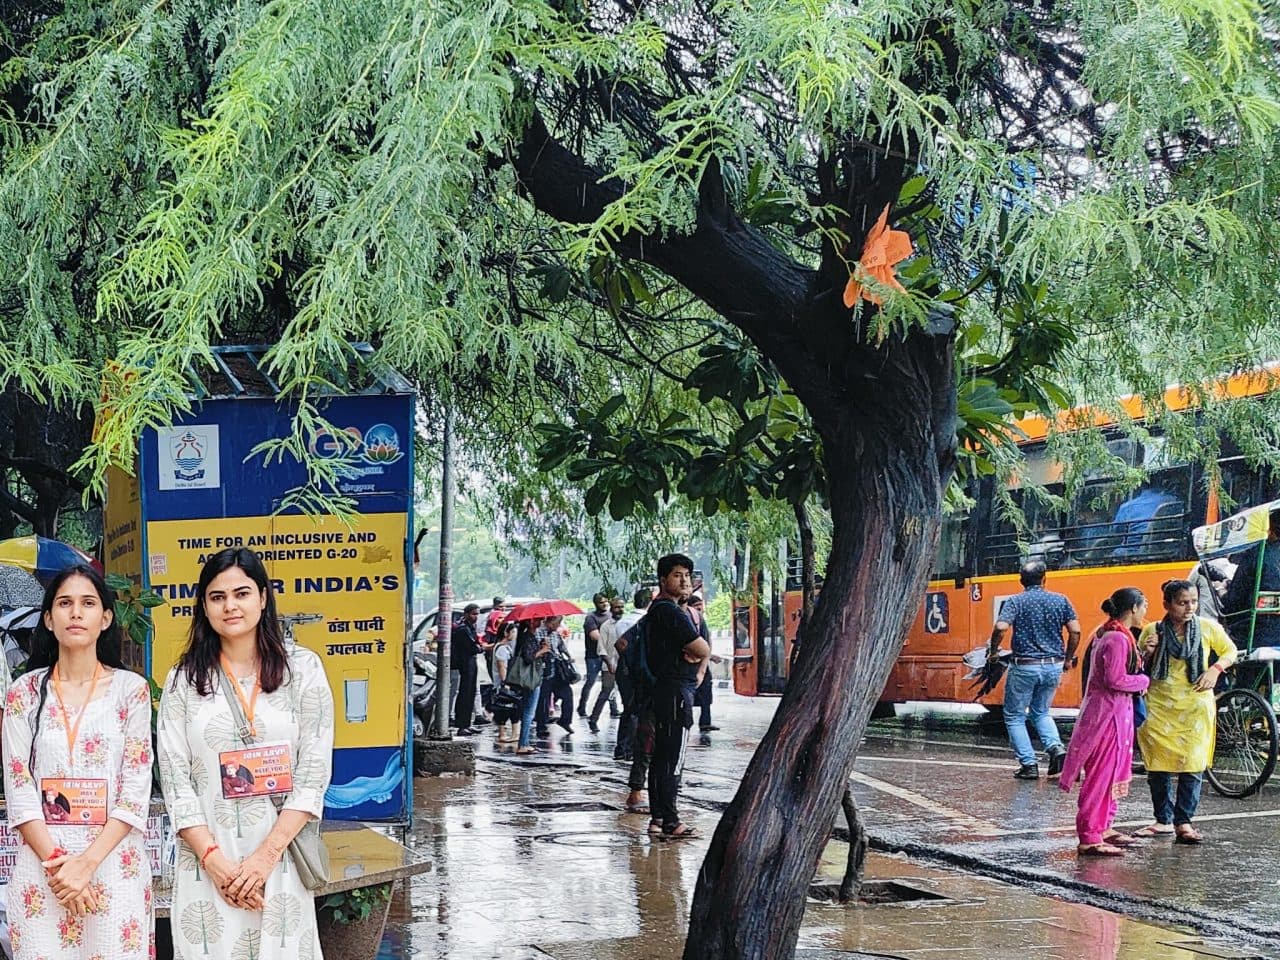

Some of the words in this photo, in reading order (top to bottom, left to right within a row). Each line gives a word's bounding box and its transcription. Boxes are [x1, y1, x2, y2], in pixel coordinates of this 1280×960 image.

[178, 538, 211, 549] TIME
[216, 537, 243, 547] FOR
[248, 535, 266, 546] AN
[271, 533, 343, 545] INCLUSIVE
[348, 532, 376, 543] AND
[327, 548, 357, 559] G-20
[151, 583, 199, 599] TIM
[295, 575, 399, 594] INDIA'S
[327, 618, 350, 632] ठंडा
[354, 616, 385, 631] पानी
